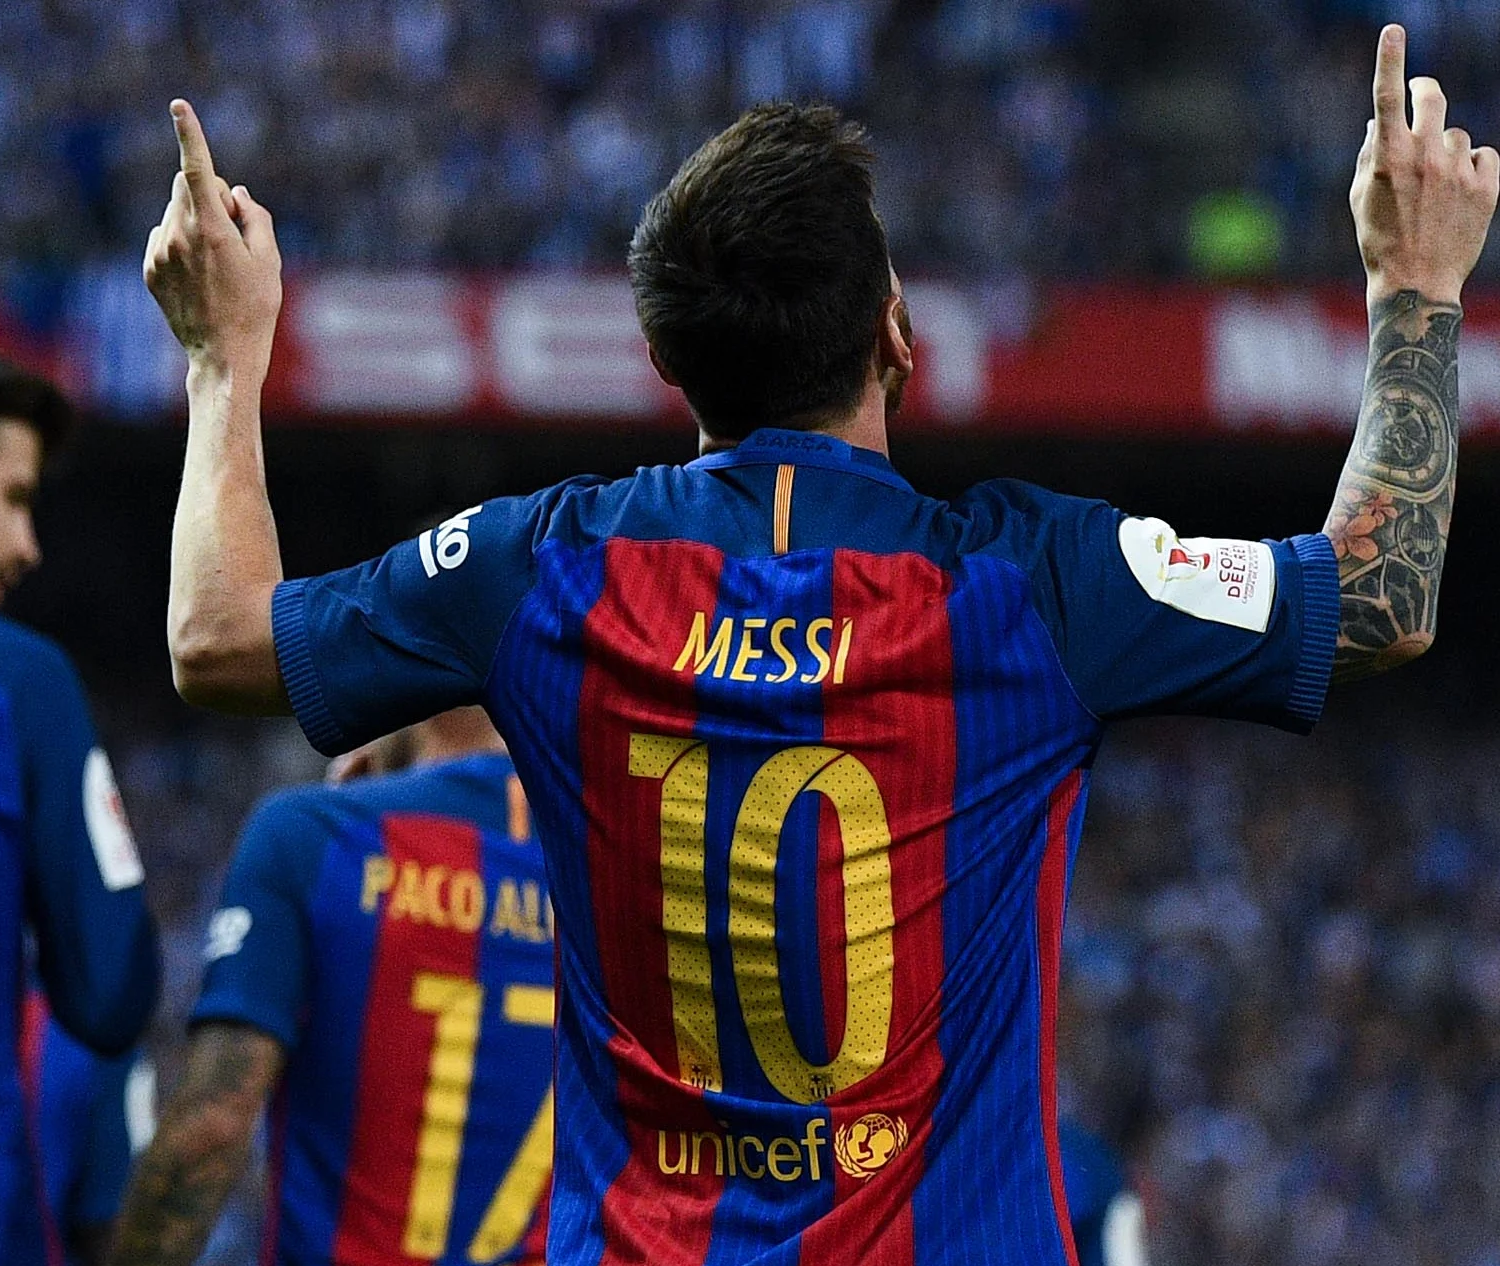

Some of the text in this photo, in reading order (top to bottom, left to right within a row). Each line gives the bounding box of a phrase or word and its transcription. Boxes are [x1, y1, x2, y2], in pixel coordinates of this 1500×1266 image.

[672, 610, 855, 685] MESSI
[359, 853, 555, 944] PACO AL
[627, 731, 896, 1106] 10
[403, 971, 555, 1265] 17
[656, 1115, 827, 1183] unicef
